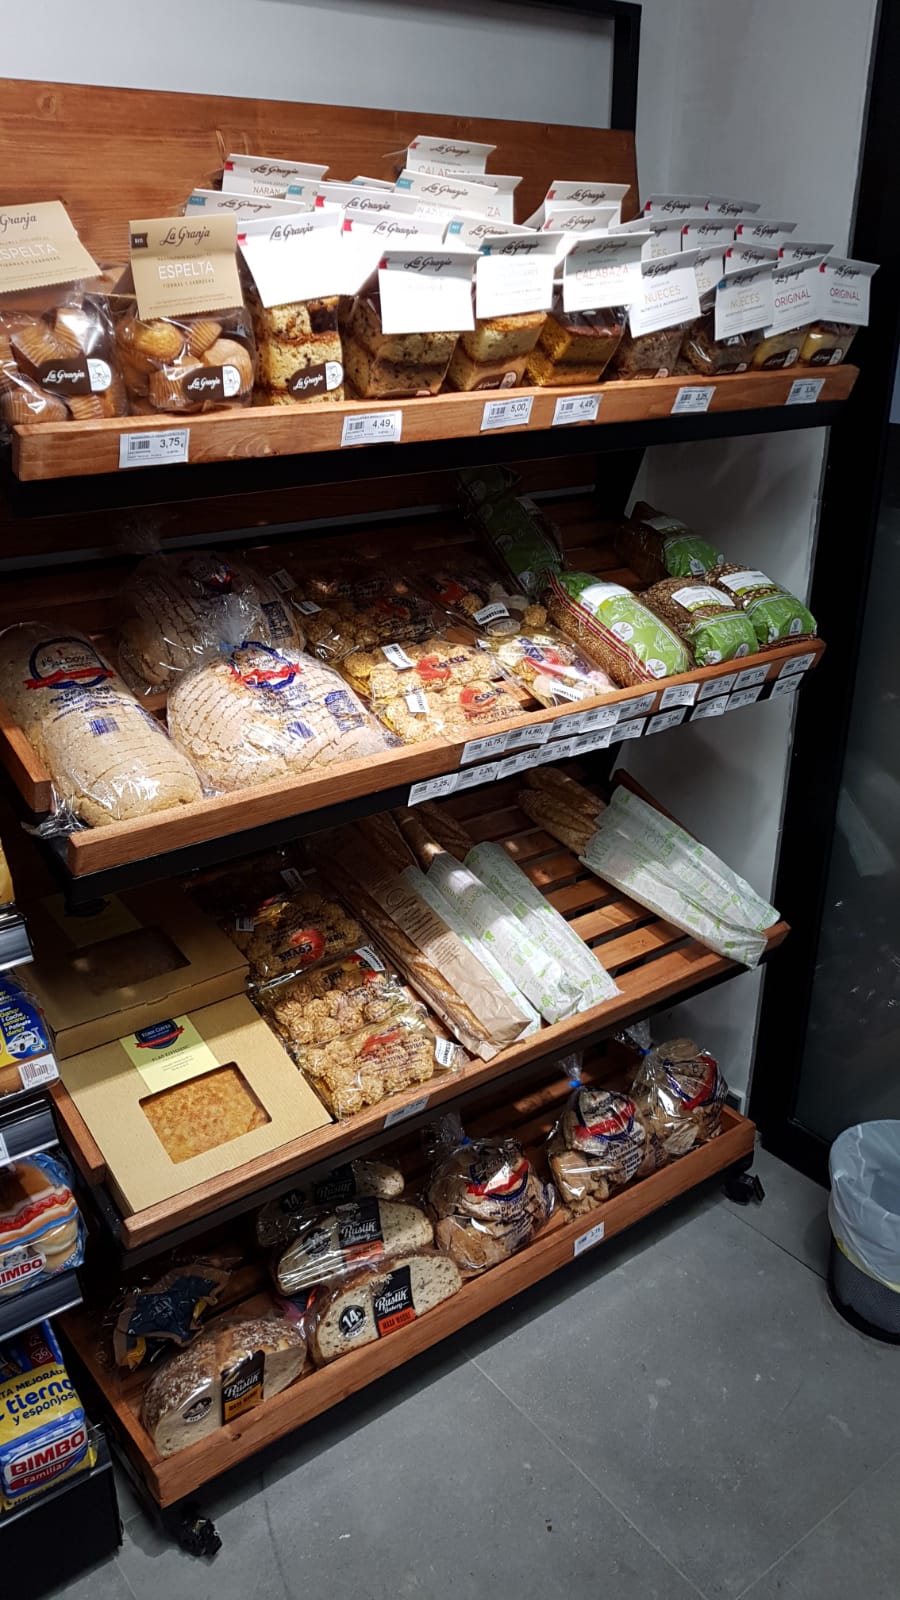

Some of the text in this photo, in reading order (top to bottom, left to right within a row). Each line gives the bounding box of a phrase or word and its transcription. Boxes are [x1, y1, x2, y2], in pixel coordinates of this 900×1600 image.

[160, 226, 211, 248] La Granja
[158, 260, 215, 280] ESPELTA
[404, 257, 452, 272] La Granja
[644, 285, 682, 305] NUECES
[775, 288, 811, 308] ORIGINAL
[829, 287, 861, 301] ORIGINAL
[42, 369, 85, 385] La Granja
[188, 377, 221, 391] La Granja
[293, 374, 324, 390] La Granja
[0, 1258, 43, 1285] IMBO
[375, 1288, 408, 1312] Rustik
[15, 1368, 66, 1391] MEJORAD
[10, 1430, 85, 1477] BIMBO
[23, 1461, 67, 1485] Familiar
